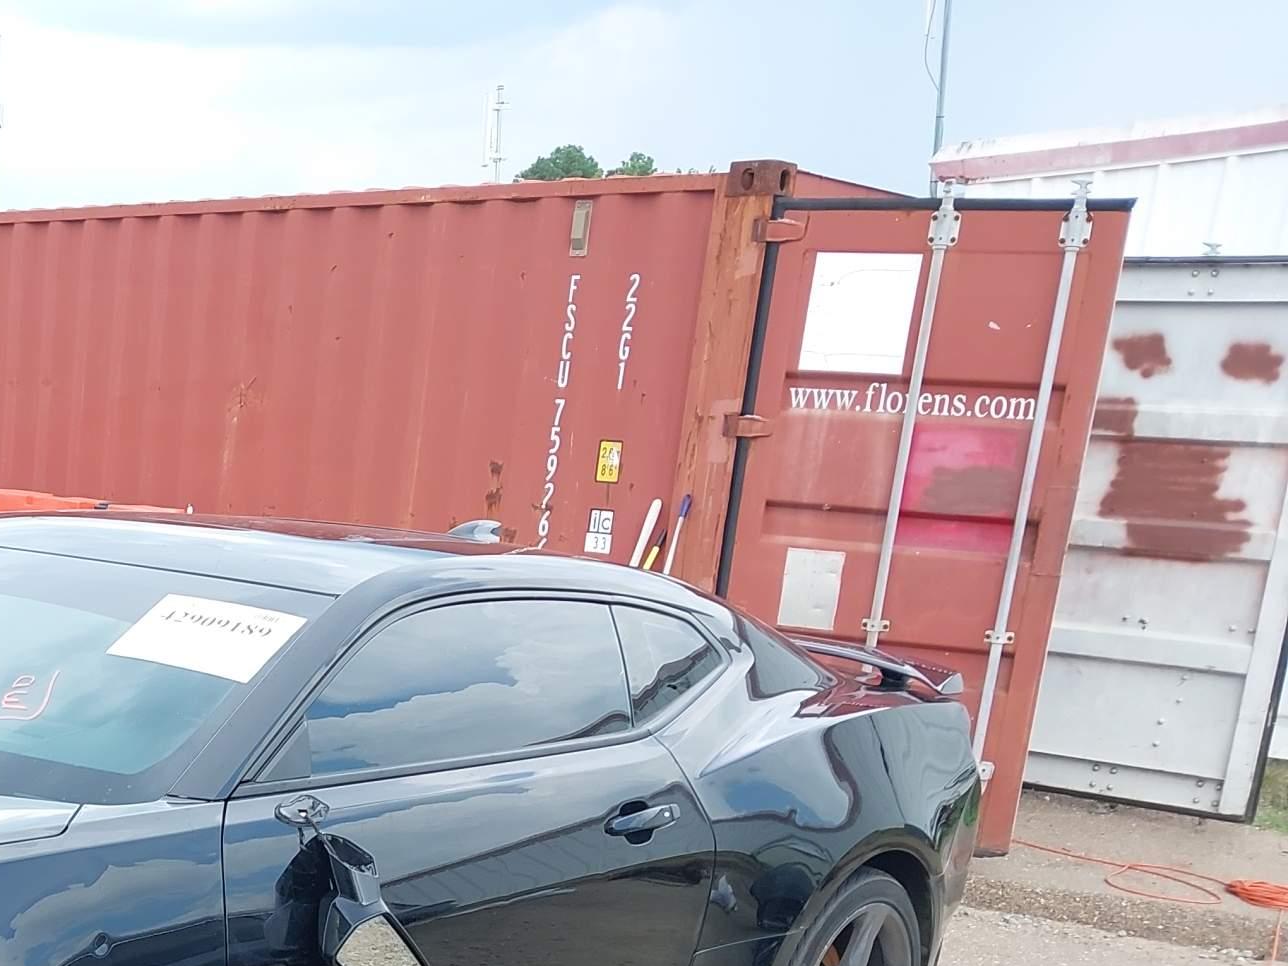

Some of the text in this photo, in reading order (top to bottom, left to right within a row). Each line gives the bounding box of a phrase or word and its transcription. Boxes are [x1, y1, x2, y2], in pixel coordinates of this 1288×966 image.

[558, 274, 581, 388] FSCU
[617, 273, 641, 390] 22G1
[593, 536, 608, 550] 33
